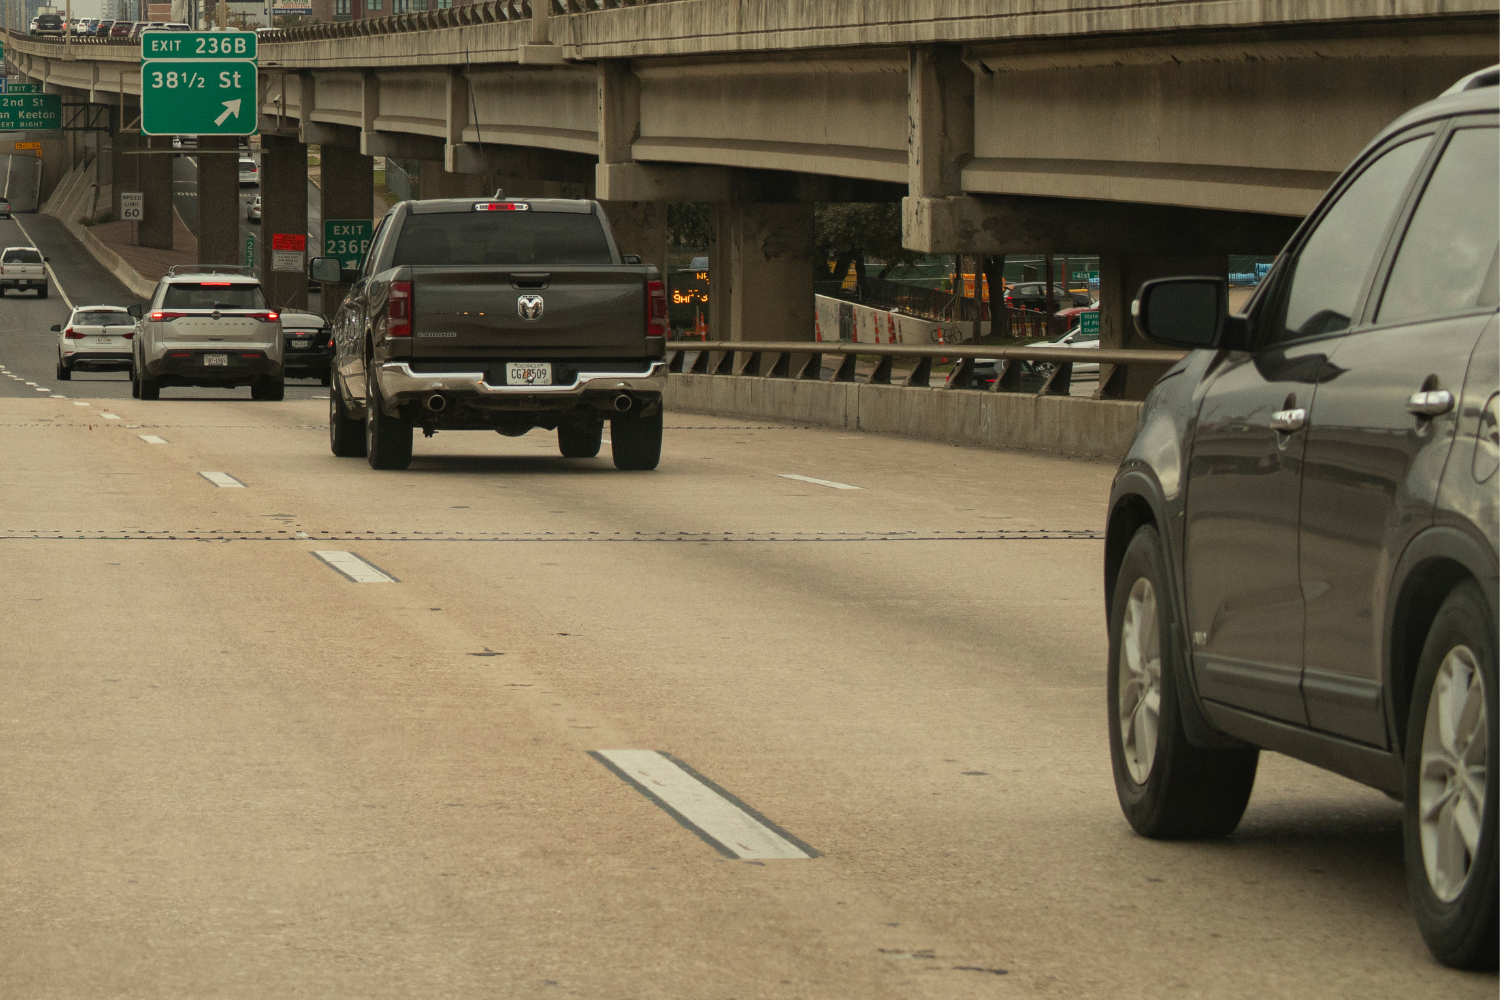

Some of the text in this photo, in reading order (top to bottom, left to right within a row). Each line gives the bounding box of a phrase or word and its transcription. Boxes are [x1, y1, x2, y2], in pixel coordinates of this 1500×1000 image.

[151, 37, 246, 54] EXIT 236B
[219, 71, 242, 89] St
[31, 85, 43, 93] 23
[32, 98, 44, 107] St
[18, 110, 56, 119] Keeton
[124, 208, 140, 217] 60
[334, 225, 363, 235] EXIT
